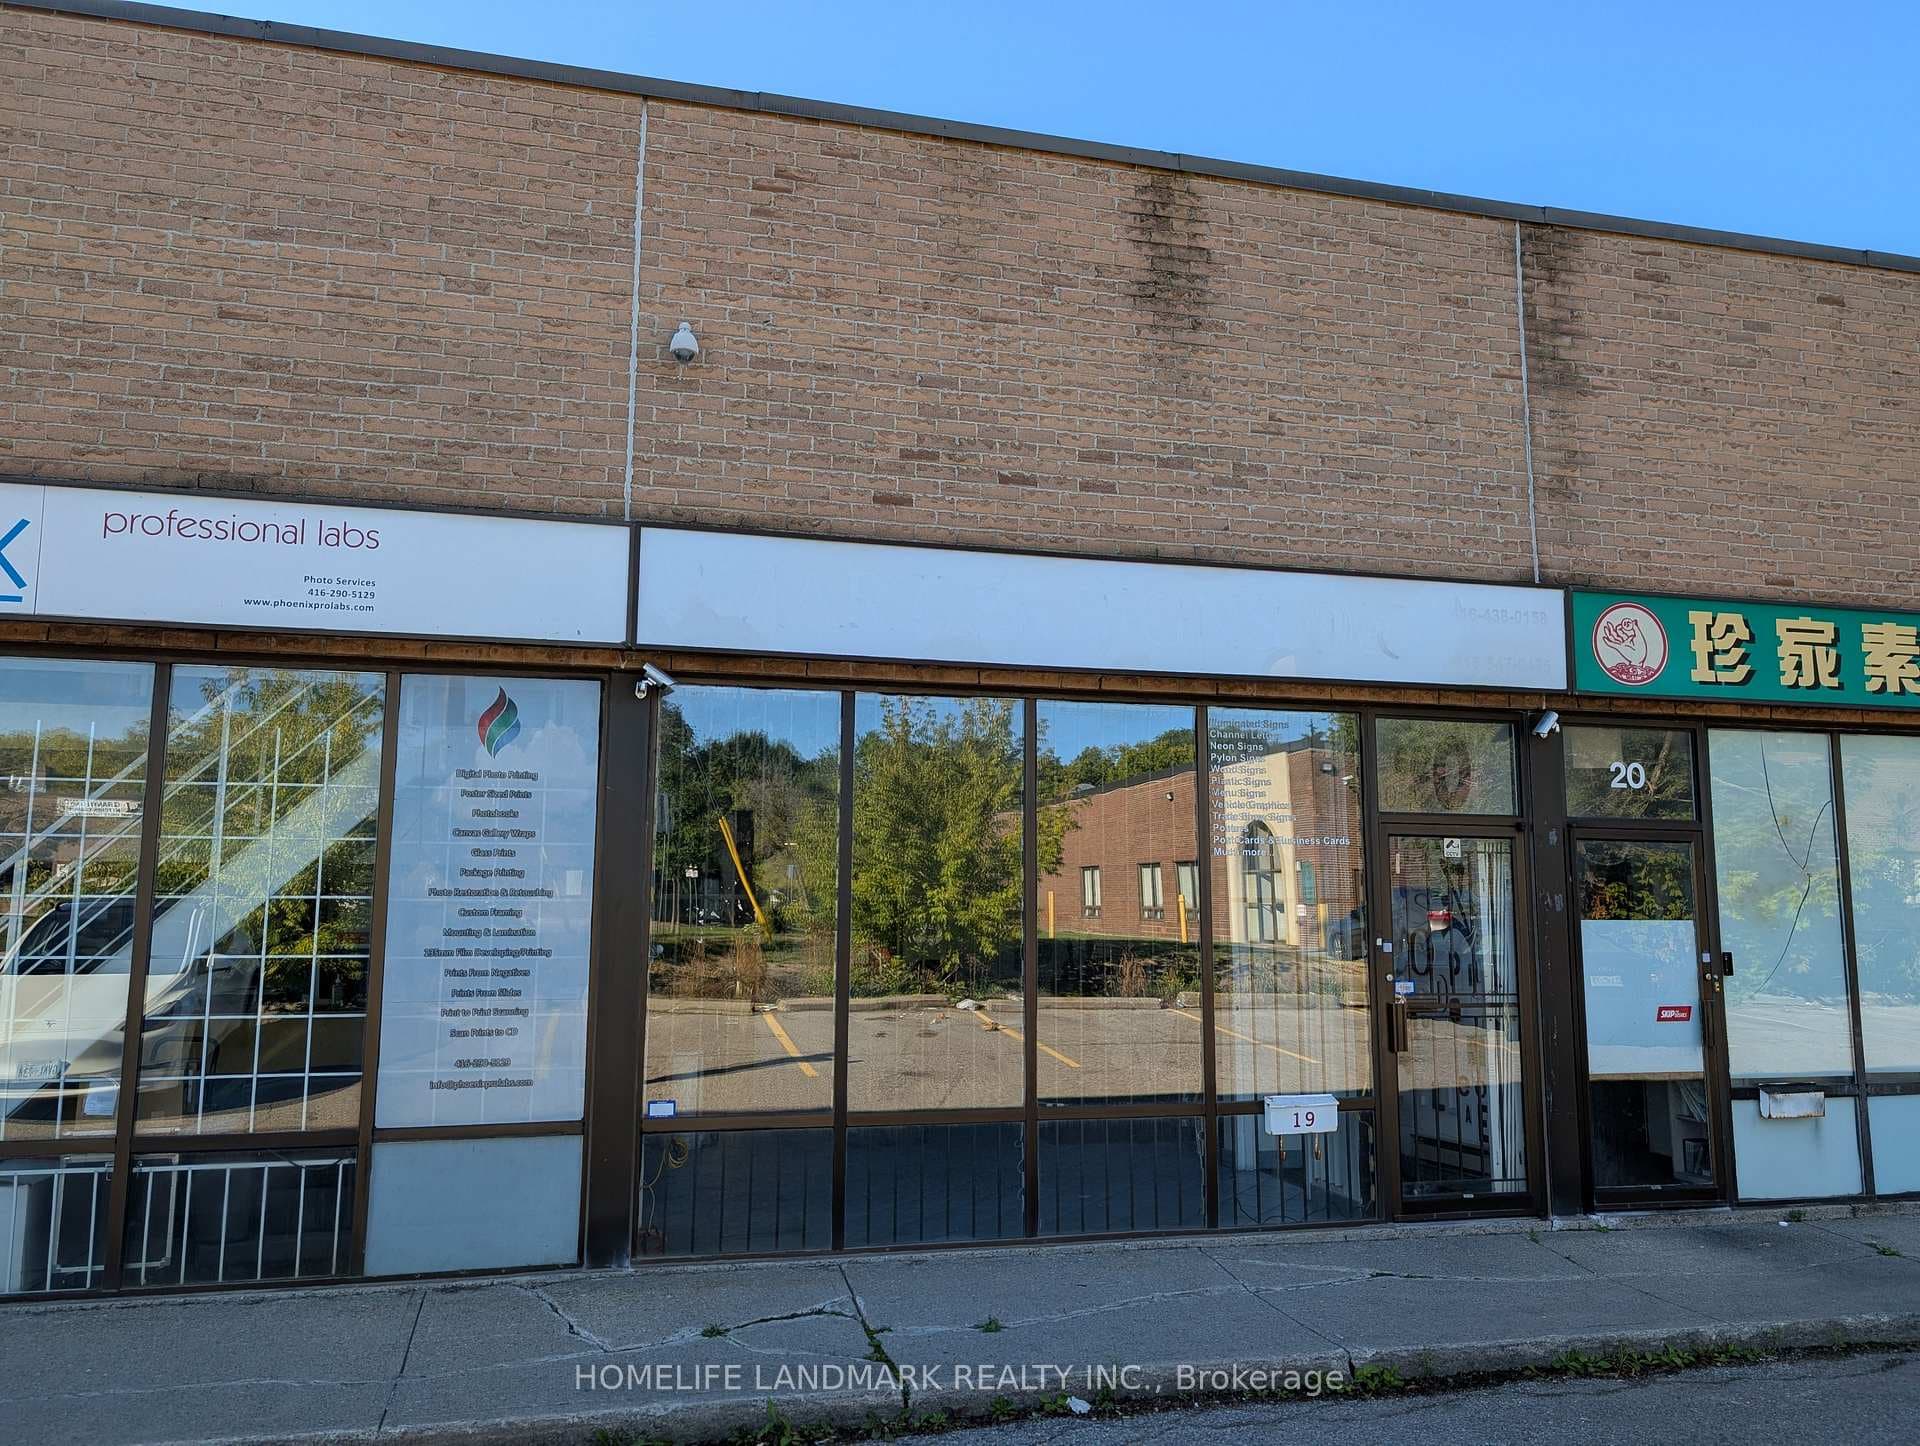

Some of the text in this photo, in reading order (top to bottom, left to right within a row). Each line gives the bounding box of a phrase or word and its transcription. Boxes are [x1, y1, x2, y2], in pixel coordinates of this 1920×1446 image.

[103, 509, 380, 550] professional labs
[303, 575, 376, 587] Photo Services
[307, 588, 376, 600] 416-290-5129
[243, 598, 375, 612] www.phoenixprolabs.com
[1263, 719, 1290, 731] Signs
[1209, 729, 1249, 739] Channel
[1210, 741, 1264, 752] Neon Signs
[1210, 753, 1266, 765] Pylon Signs
[455, 769, 539, 781] Digital Photo Printing
[1240, 766, 1267, 776] Signs
[1609, 761, 1646, 789] 20
[1244, 777, 1272, 788] Signs
[460, 789, 532, 799] Poster Sized Prints
[1211, 787, 1267, 799] Menu Signs
[472, 808, 519, 818] Photobooks
[452, 828, 536, 839] Canvas Gallery Wraps
[1238, 836, 1265, 845] Cards
[1323, 836, 1351, 846] Cards
[471, 848, 516, 857] Glass Prints
[459, 867, 525, 879] Package Printing
[428, 887, 553, 898] Photo Restoration & Retouching
[458, 907, 522, 918] Custom Framing
[442, 928, 536, 938] Mounting & Lamination
[455, 948, 473, 957] Film
[443, 967, 530, 978] Prints From Negatives
[451, 988, 522, 998] Prints From Slides
[440, 1008, 460, 1017] Print
[461, 1008, 471, 1017] to
[472, 1008, 492, 1017] Print
[471, 1028, 494, 1037] Prints
[494, 1028, 504, 1036] to
[505, 1027, 518, 1036] CD
[1293, 1111, 1315, 1128] 19
